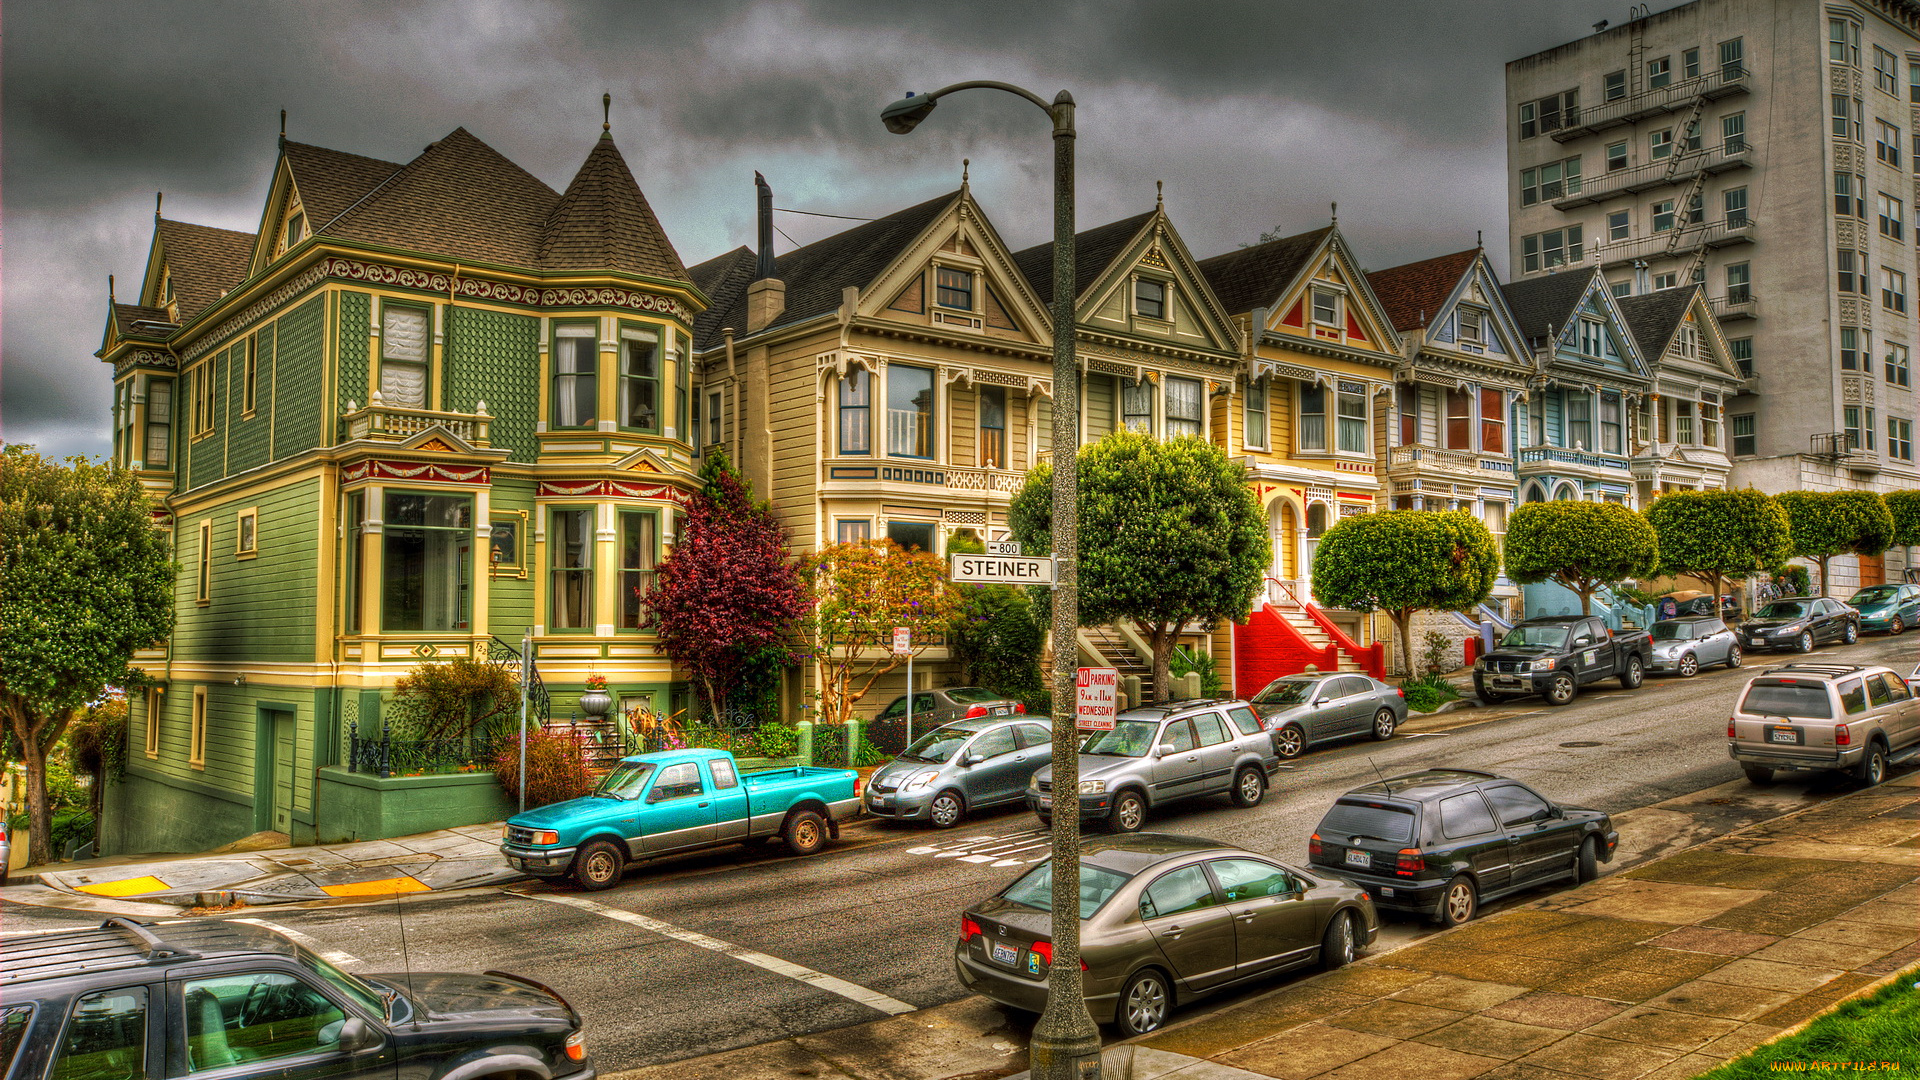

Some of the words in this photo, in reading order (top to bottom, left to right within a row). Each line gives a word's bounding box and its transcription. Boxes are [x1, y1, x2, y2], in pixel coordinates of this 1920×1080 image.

[999, 543, 1017, 553] 800
[962, 560, 1039, 577] STEINER
[1078, 670, 1089, 685] NO
[1091, 674, 1115, 686] PARKING
[1078, 705, 1114, 716] WEDNESDAY
